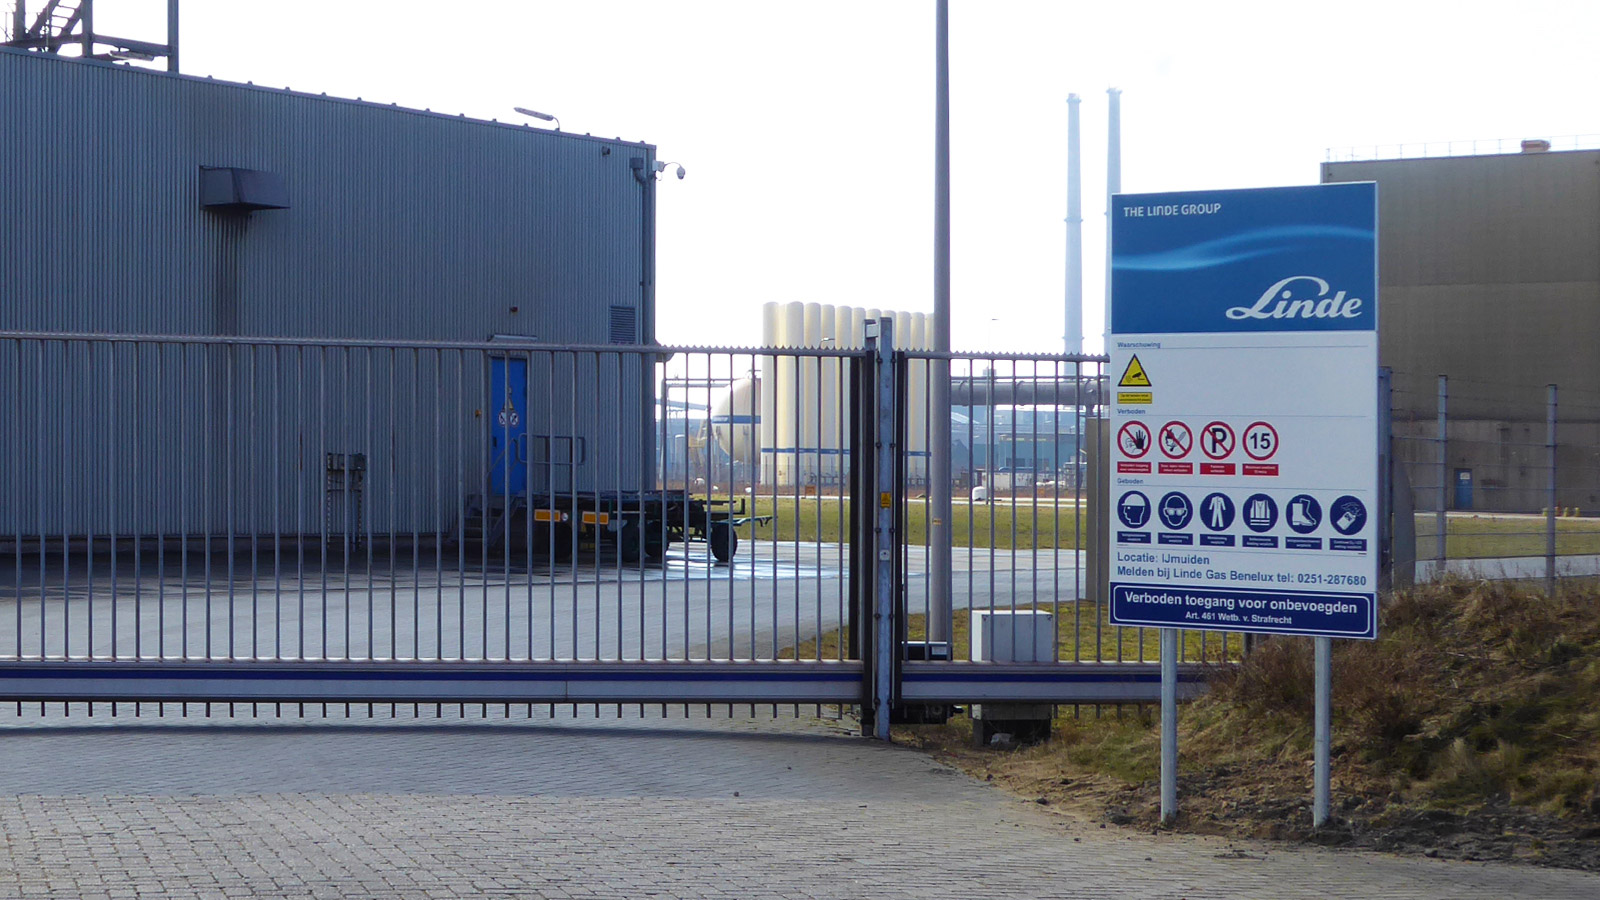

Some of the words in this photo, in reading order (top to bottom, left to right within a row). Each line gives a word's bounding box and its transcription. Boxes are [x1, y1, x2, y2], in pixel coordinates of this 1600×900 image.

[1123, 206, 1144, 217] THE
[1147, 204, 1179, 216] LINDE
[1181, 202, 1221, 215] GROUP
[1225, 275, 1362, 320] Linde
[1250, 432, 1271, 450] 15
[1117, 552, 1158, 563] Locatie:
[1162, 553, 1210, 565] IJmuiden
[1117, 566, 1154, 577] Melden
[1157, 567, 1171, 580] bij
[1173, 568, 1202, 579] Linde
[1206, 569, 1227, 580] Gas
[1230, 570, 1274, 582] Benelux
[1277, 572, 1294, 583] tel:
[1297, 573, 1367, 586] 0251-287680
[1124, 591, 1182, 605] Verboden
[1185, 594, 1235, 610] toegang
[1238, 599, 1267, 609] voor
[1270, 598, 1357, 615] onbevoegden
[1185, 611, 1200, 620] Art.
[1201, 612, 1215, 621] 461
[1218, 612, 1241, 622] Wetb.
[1251, 614, 1292, 624] Strafrecht
